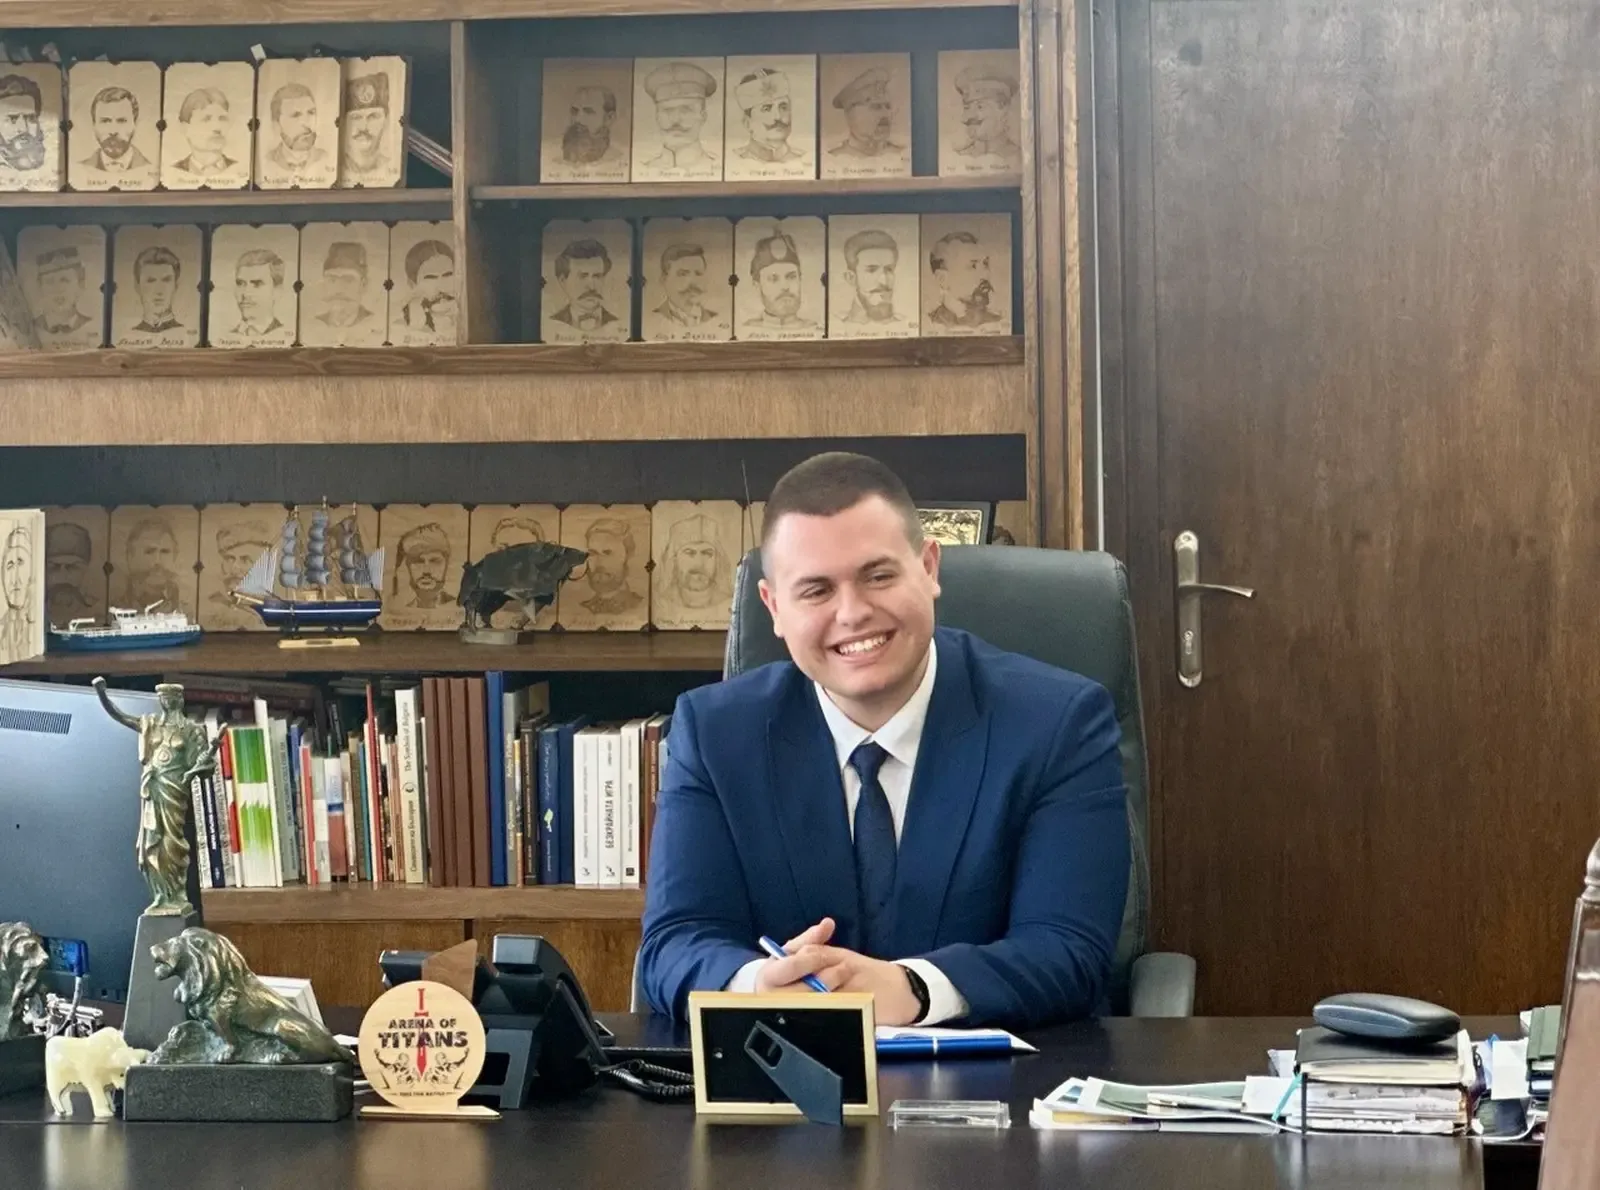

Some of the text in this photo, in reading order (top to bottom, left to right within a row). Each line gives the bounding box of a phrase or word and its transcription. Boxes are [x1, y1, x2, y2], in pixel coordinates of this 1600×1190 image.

[604, 780, 615, 849] БЕЗКРАЙНАТА ИГРА
[388, 1018, 457, 1029] ARENA OF
[378, 1031, 469, 1048] TITANS
